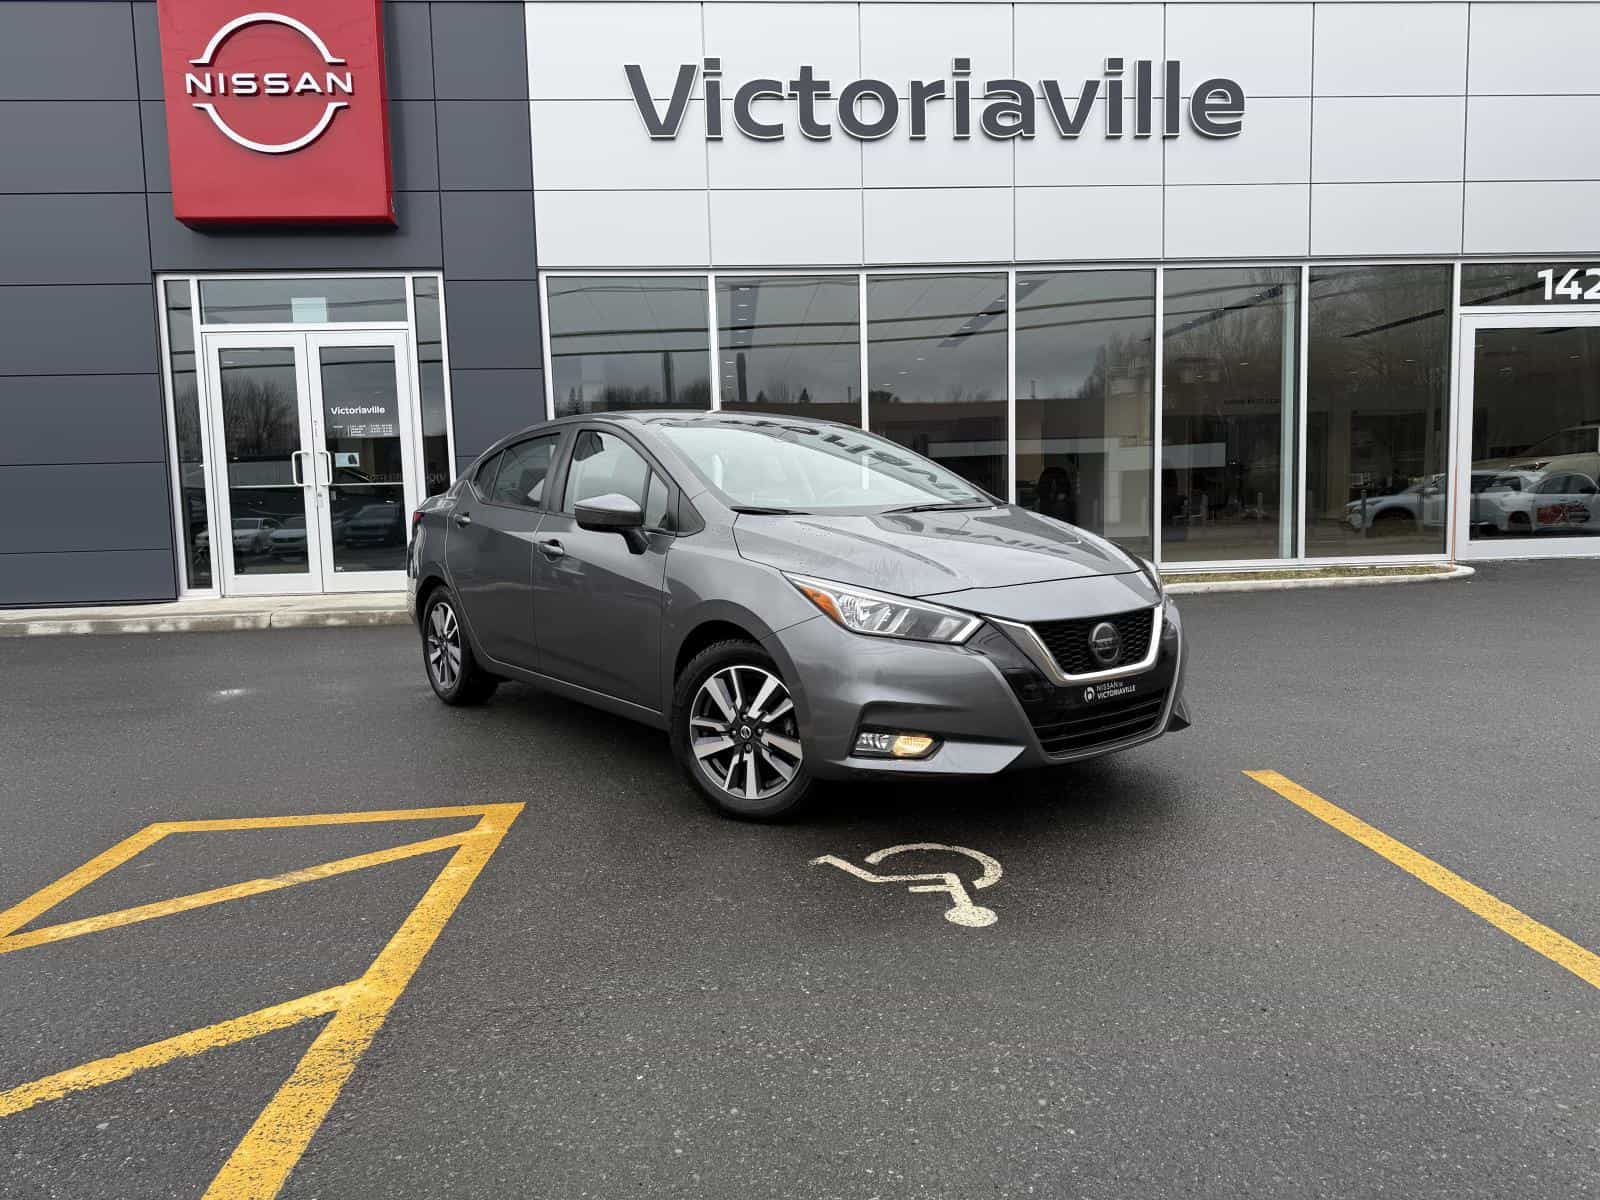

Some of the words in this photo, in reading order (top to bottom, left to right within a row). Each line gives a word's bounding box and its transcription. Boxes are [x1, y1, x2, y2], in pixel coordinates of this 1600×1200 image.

[184, 72, 353, 94] NISSAN
[624, 57, 1247, 140] Victoriaville
[330, 406, 386, 415] Victoriaville
